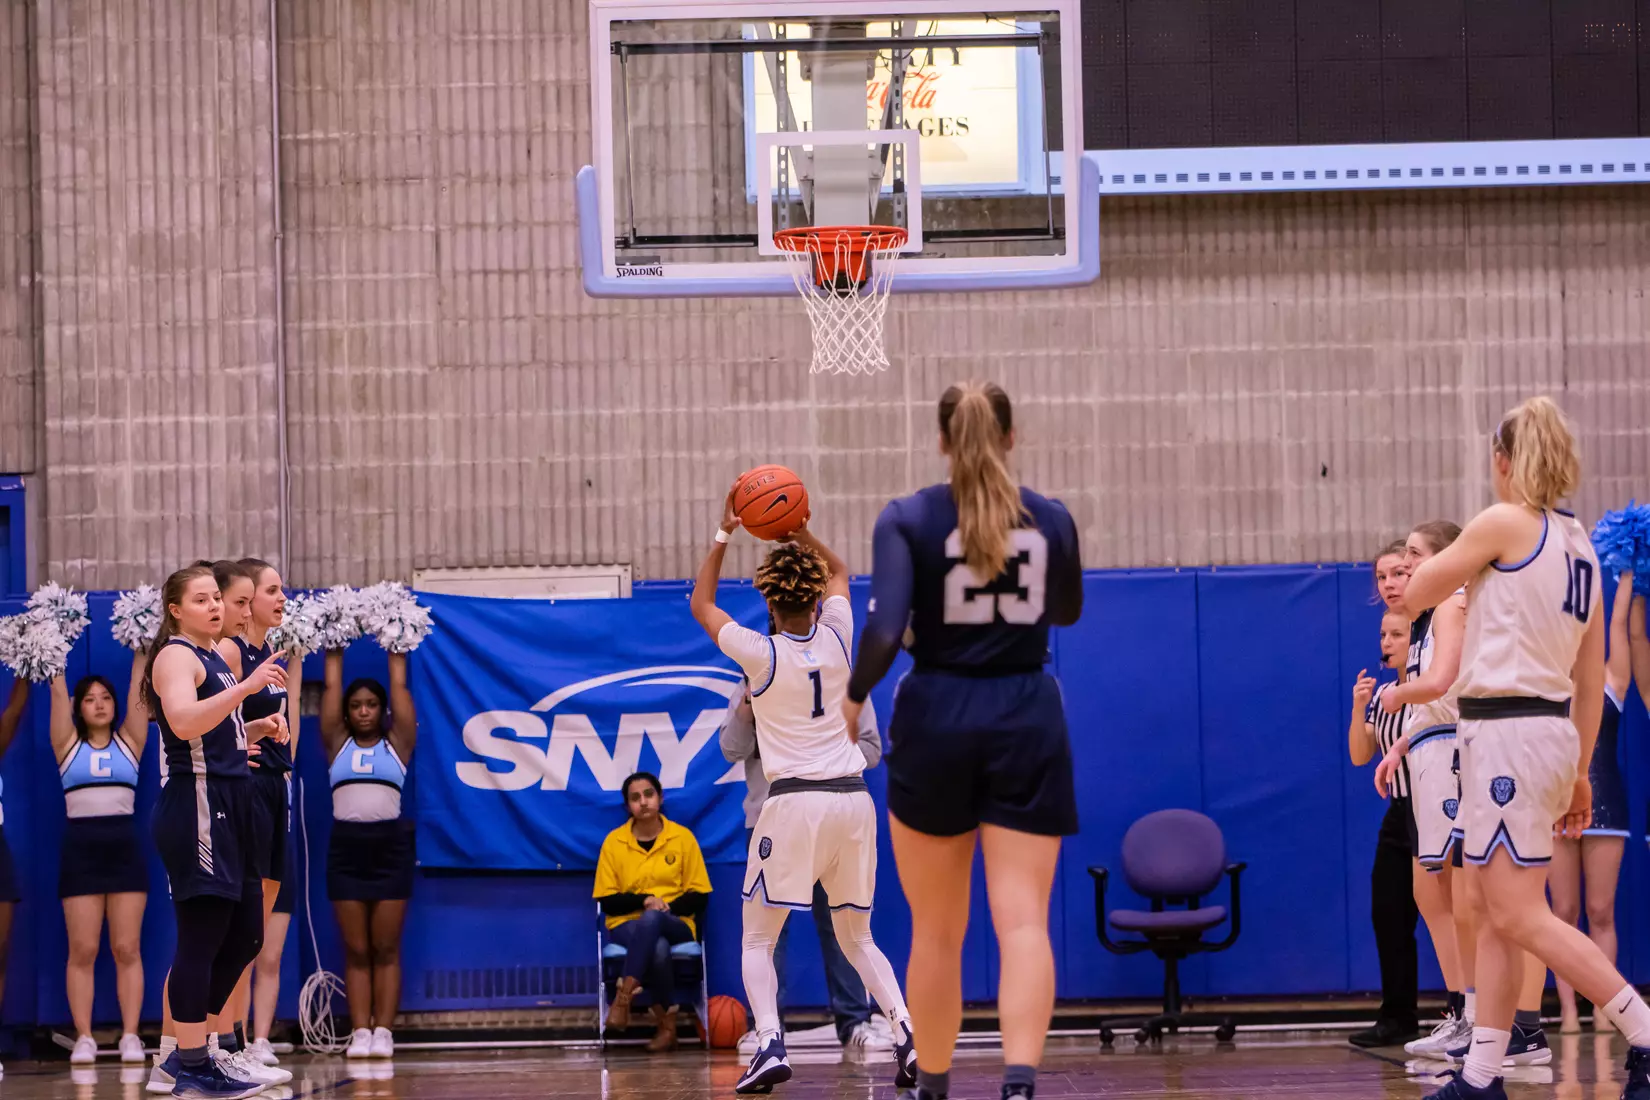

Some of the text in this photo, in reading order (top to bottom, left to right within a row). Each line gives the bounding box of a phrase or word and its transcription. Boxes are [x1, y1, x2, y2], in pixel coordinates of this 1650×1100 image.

[616, 266, 663, 278] SPALDING
[943, 527, 1048, 625] 23
[1562, 550, 1593, 624] 10
[808, 669, 825, 719] 1
[90, 751, 112, 778] C
[351, 748, 375, 775] C
[455, 709, 727, 791] SNY
